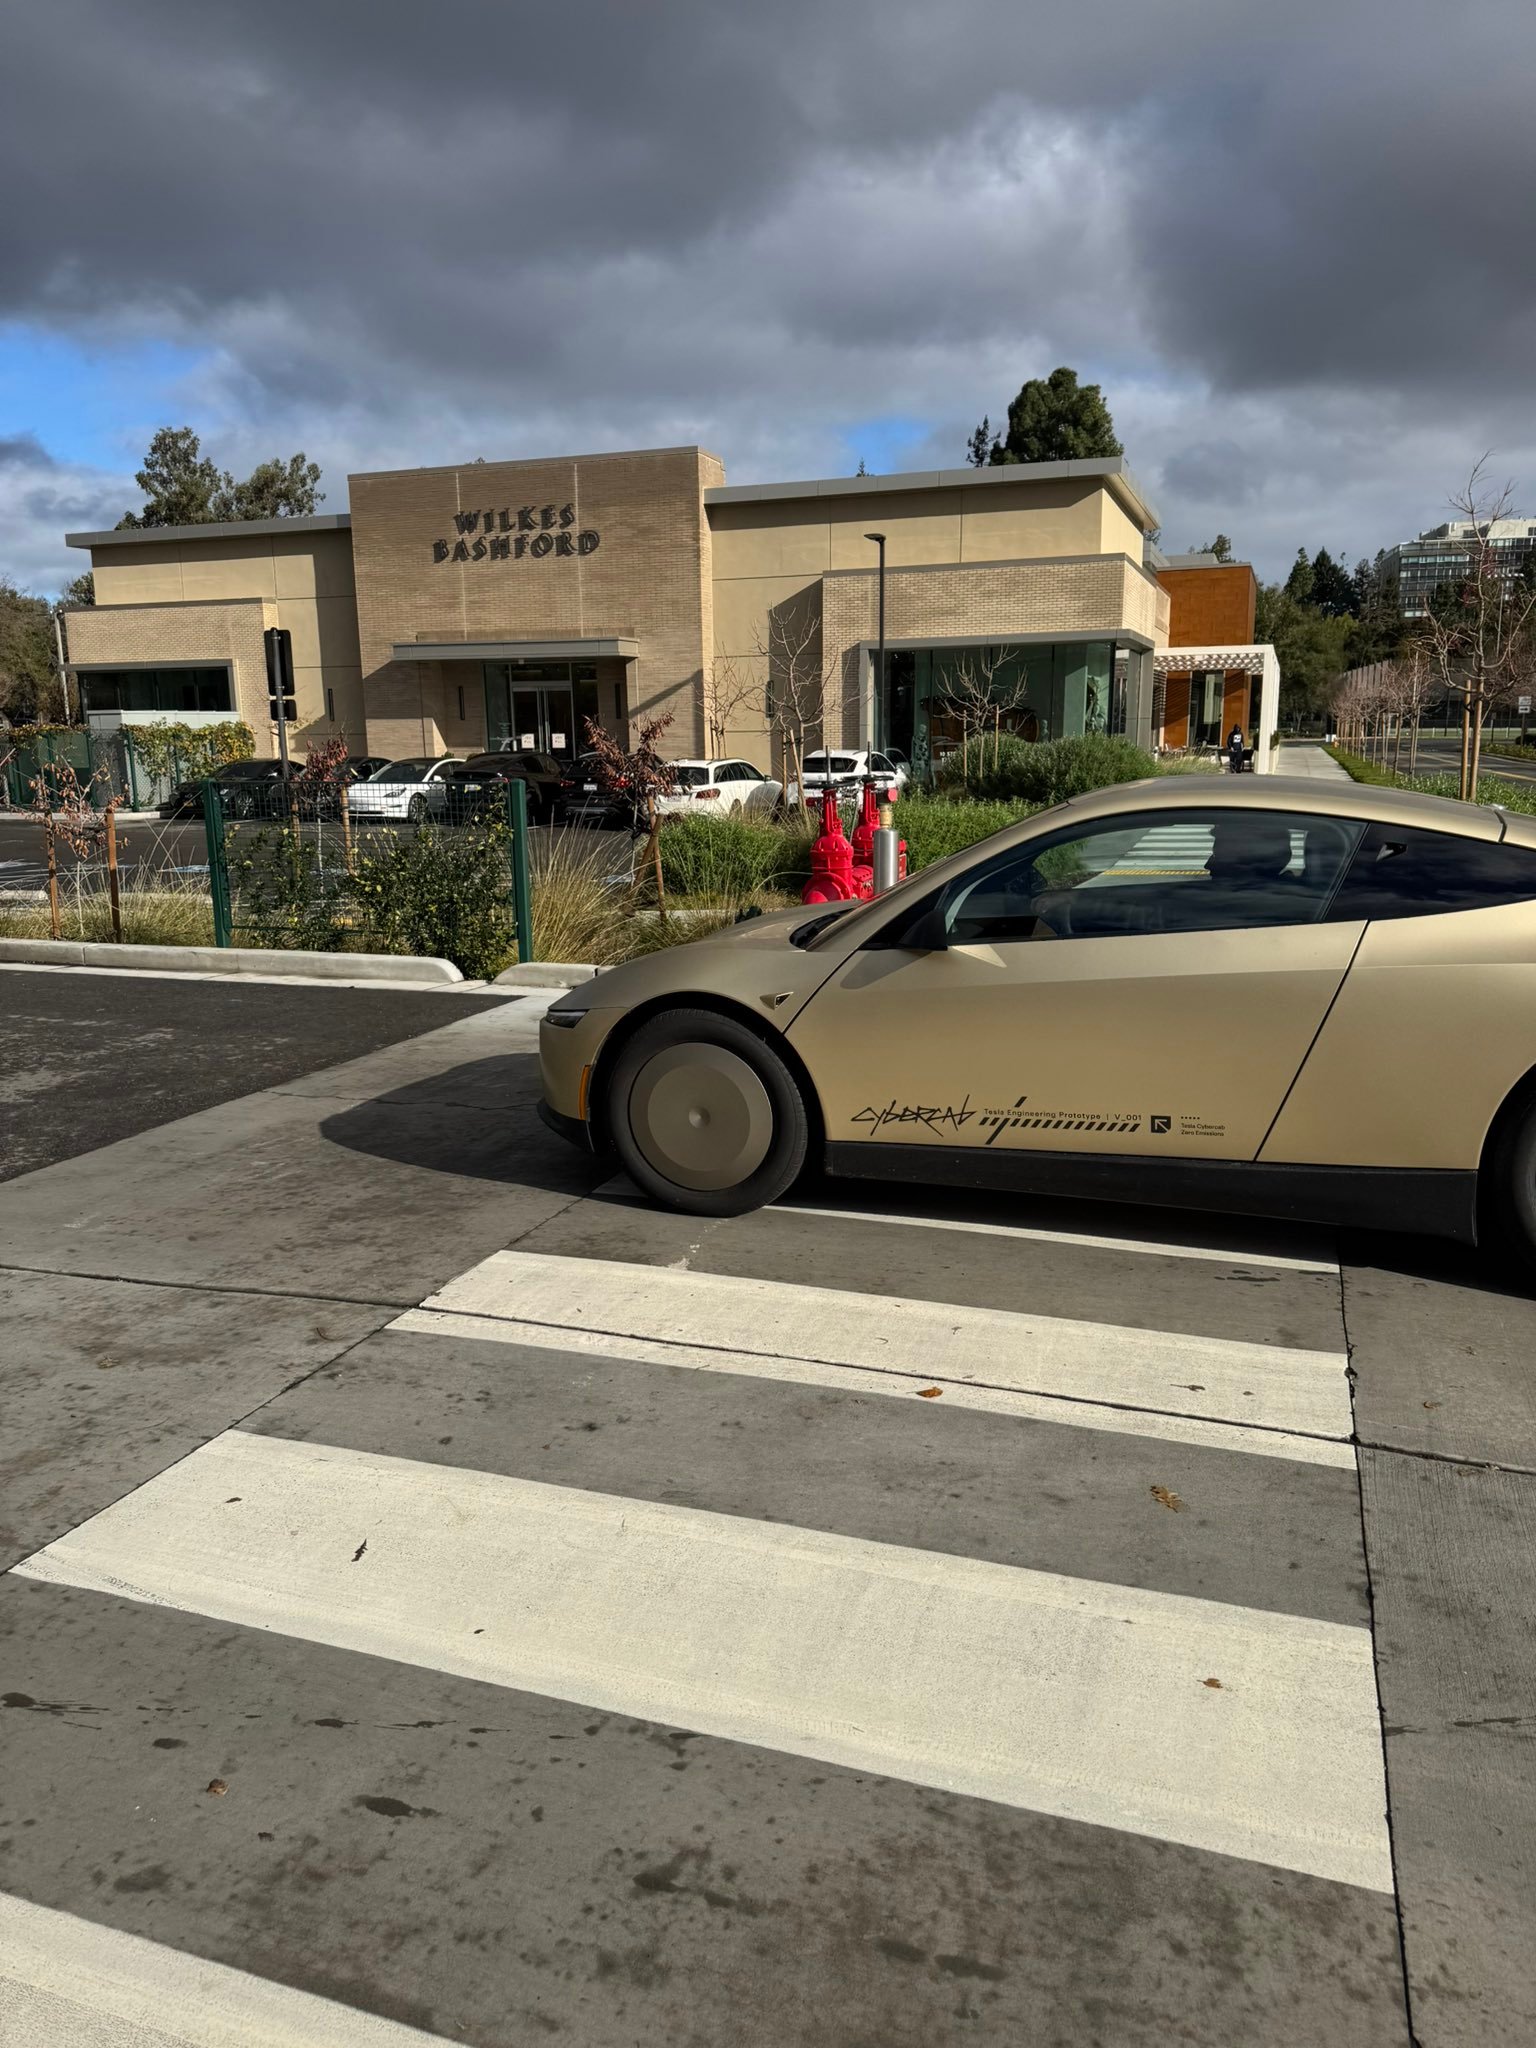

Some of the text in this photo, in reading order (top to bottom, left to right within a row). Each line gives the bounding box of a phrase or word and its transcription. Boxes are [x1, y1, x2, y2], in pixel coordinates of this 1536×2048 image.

[453, 503, 575, 535] WILKES
[432, 530, 600, 564] BASHFORD
[984, 1108, 1005, 1116] Tesla
[1007, 1109, 1057, 1119] Engineering
[1059, 1111, 1101, 1121] Prototype
[1114, 1113, 1142, 1122] V_001
